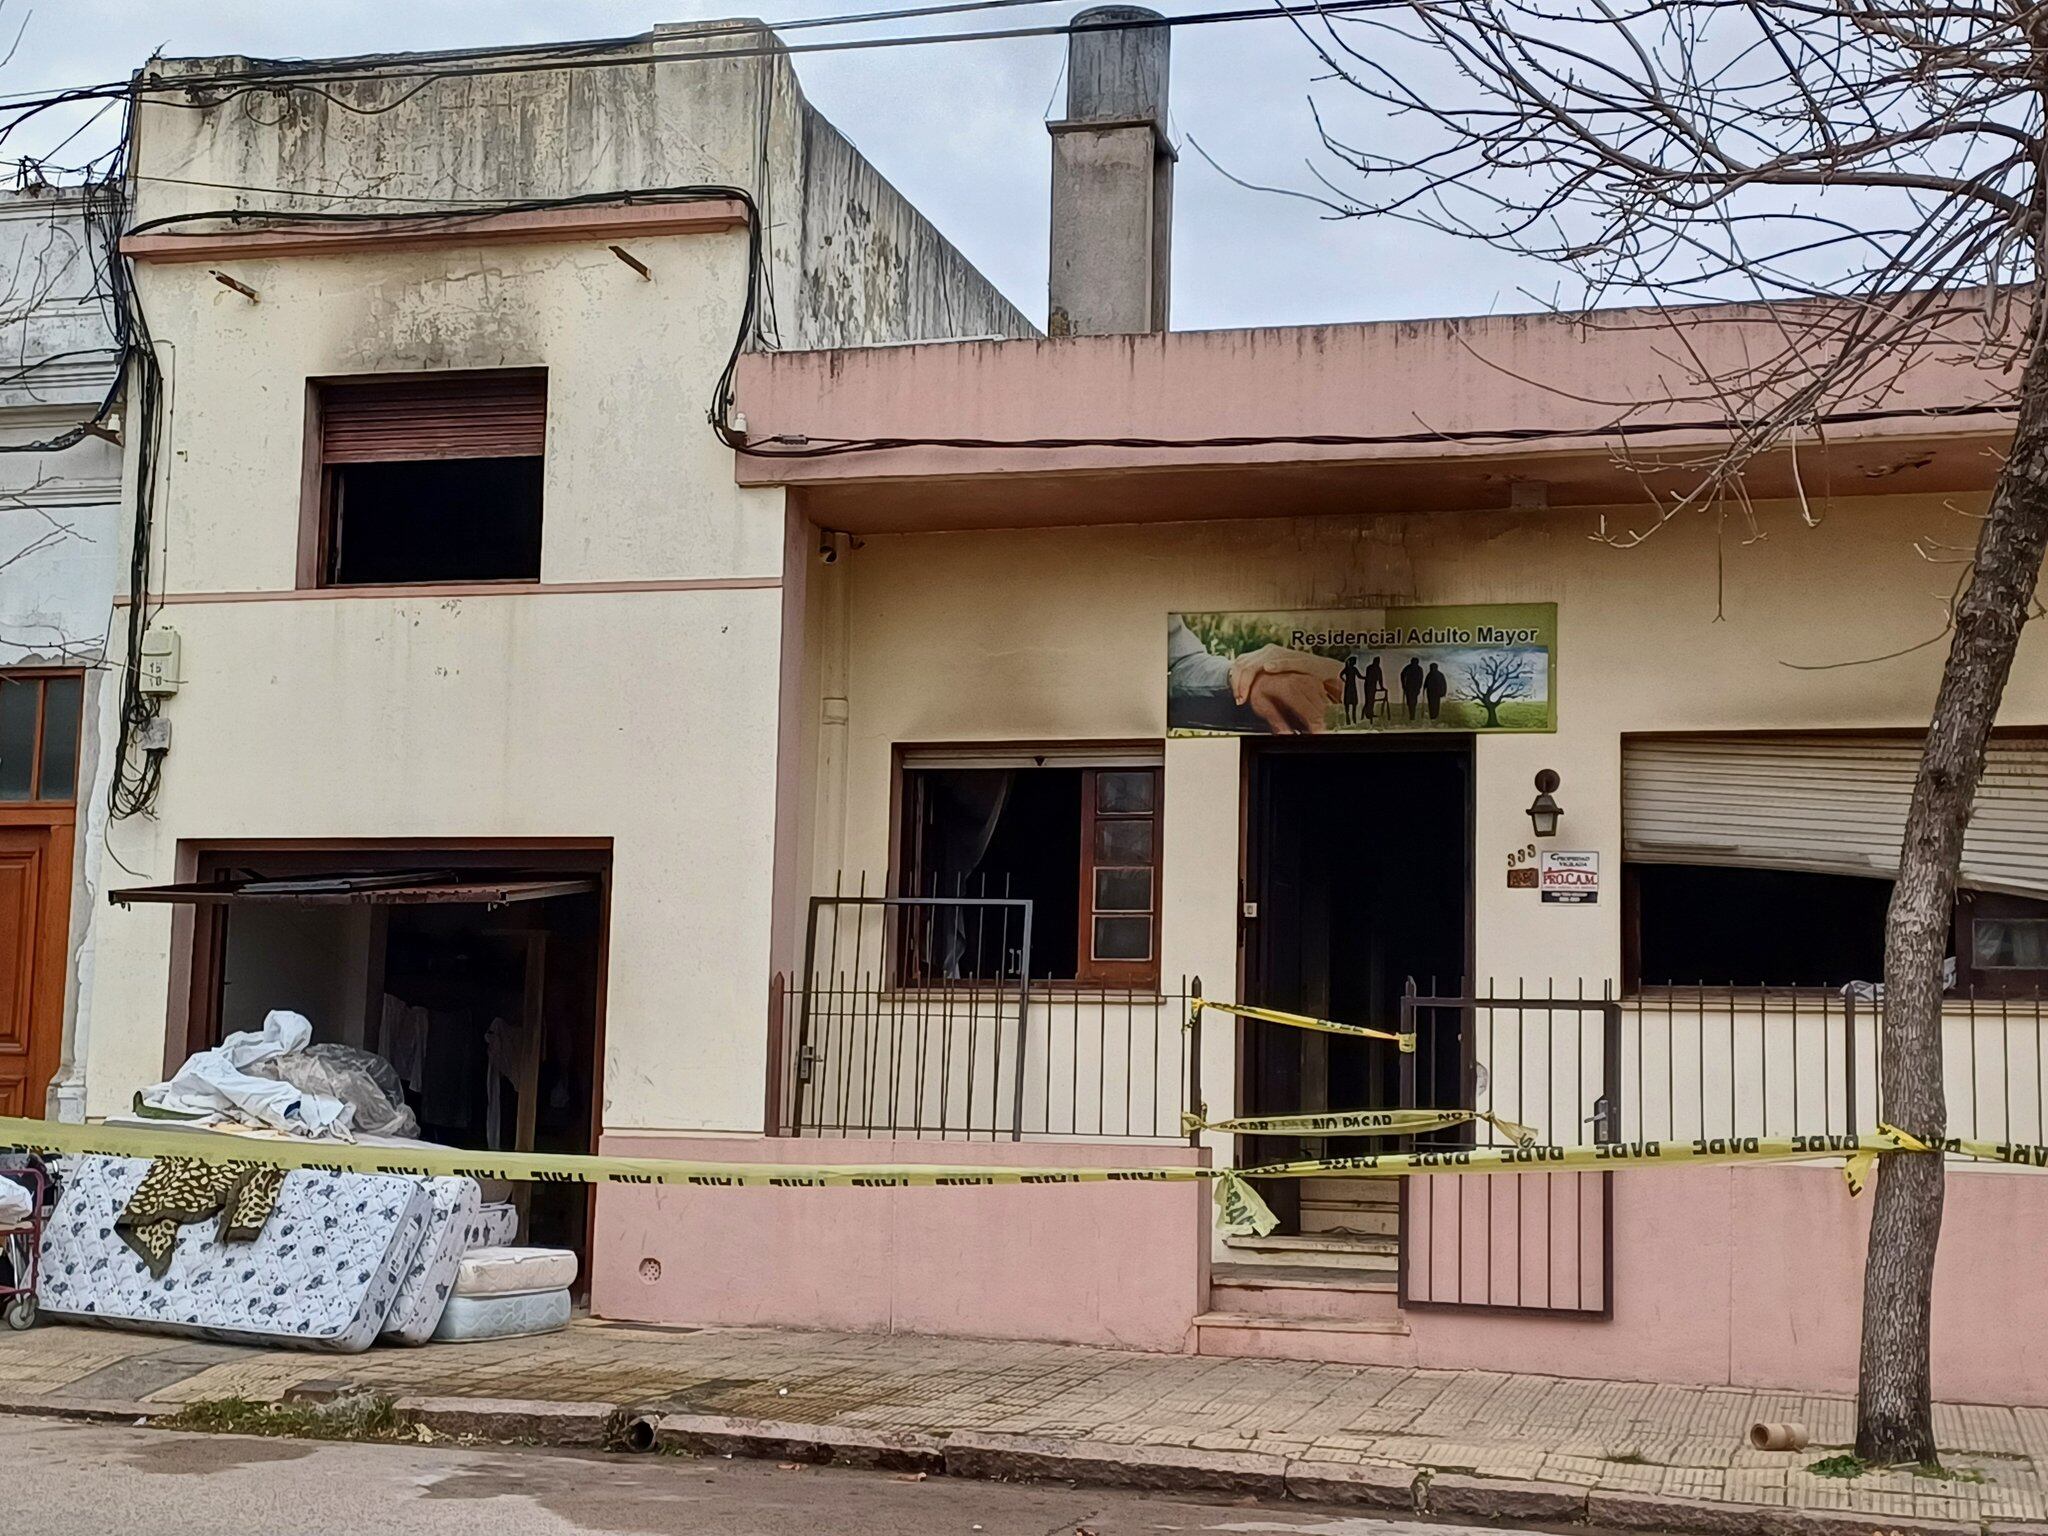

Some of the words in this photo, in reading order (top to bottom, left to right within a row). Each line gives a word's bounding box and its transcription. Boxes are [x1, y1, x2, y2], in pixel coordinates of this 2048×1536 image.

[1291, 629, 1402, 647] Residencial
[1407, 628, 1471, 645] Adulto
[1477, 627, 1538, 647] Mayor
